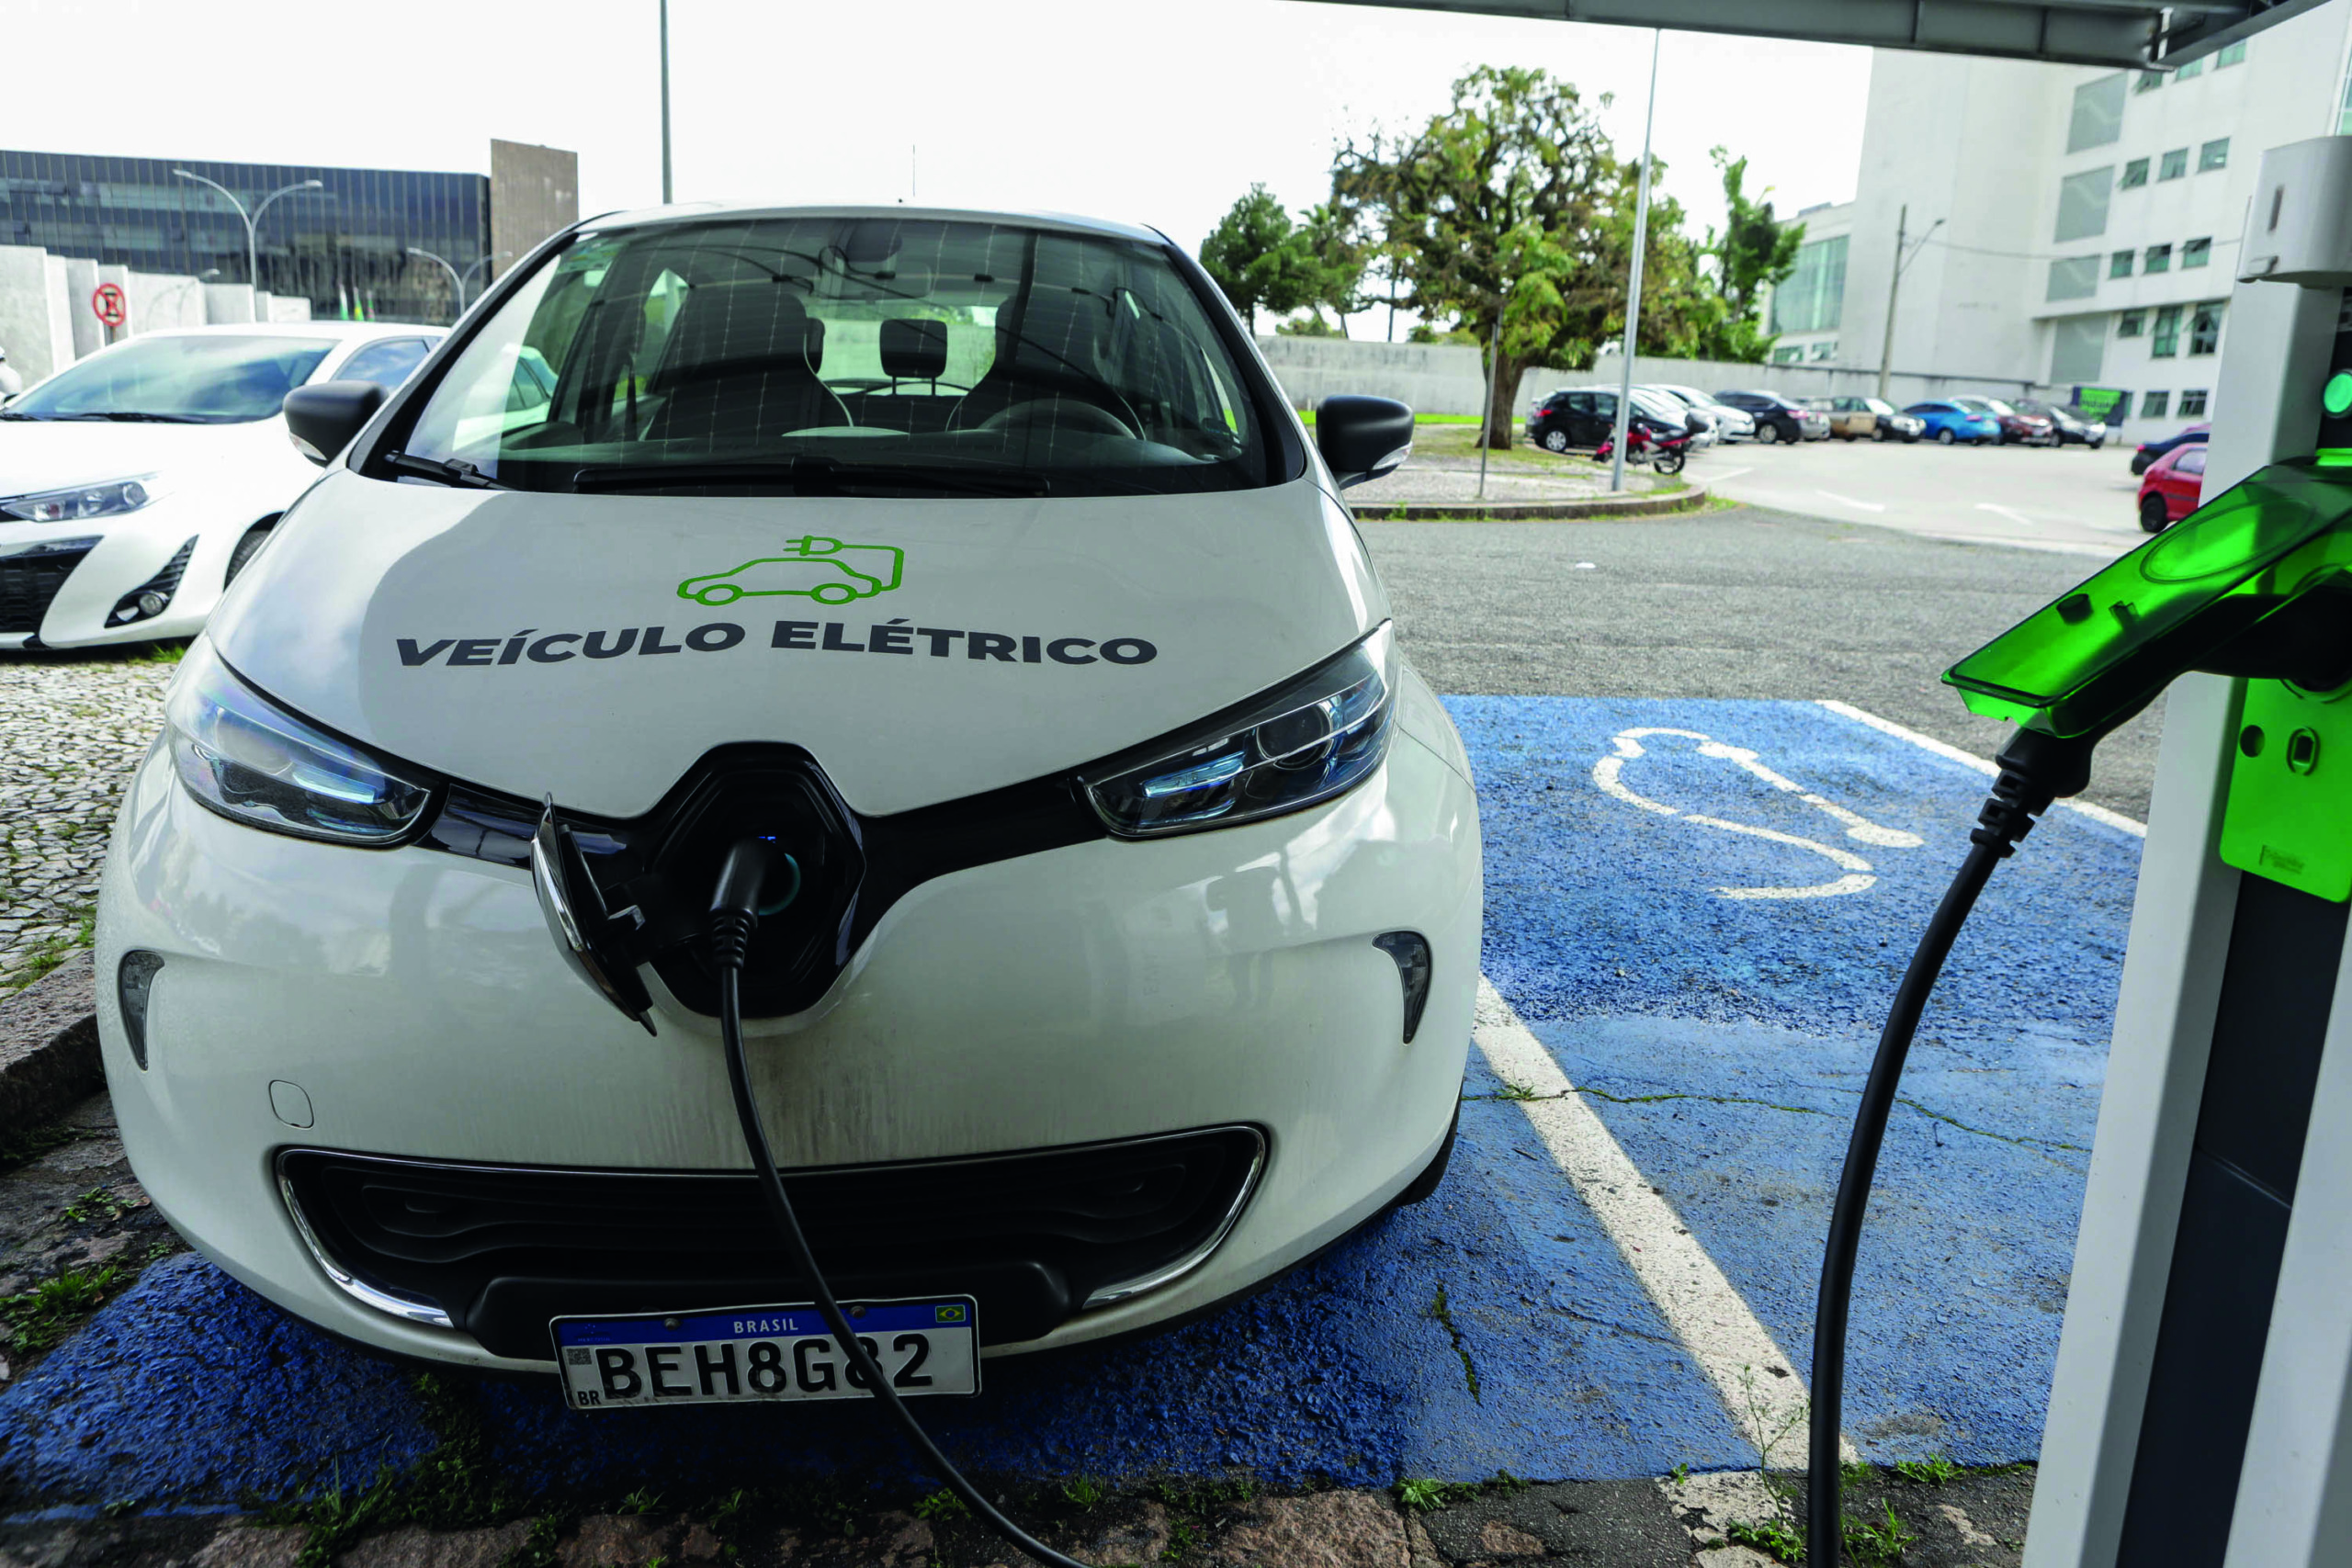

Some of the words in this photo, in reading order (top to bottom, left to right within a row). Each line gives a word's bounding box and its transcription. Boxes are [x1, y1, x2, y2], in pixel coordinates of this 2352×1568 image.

[397, 622, 745, 667] VEÍCULO
[772, 618, 1157, 664] ELÉTRICO
[732, 1317, 798, 1334] BRASIL
[577, 1390, 600, 1405] BR
